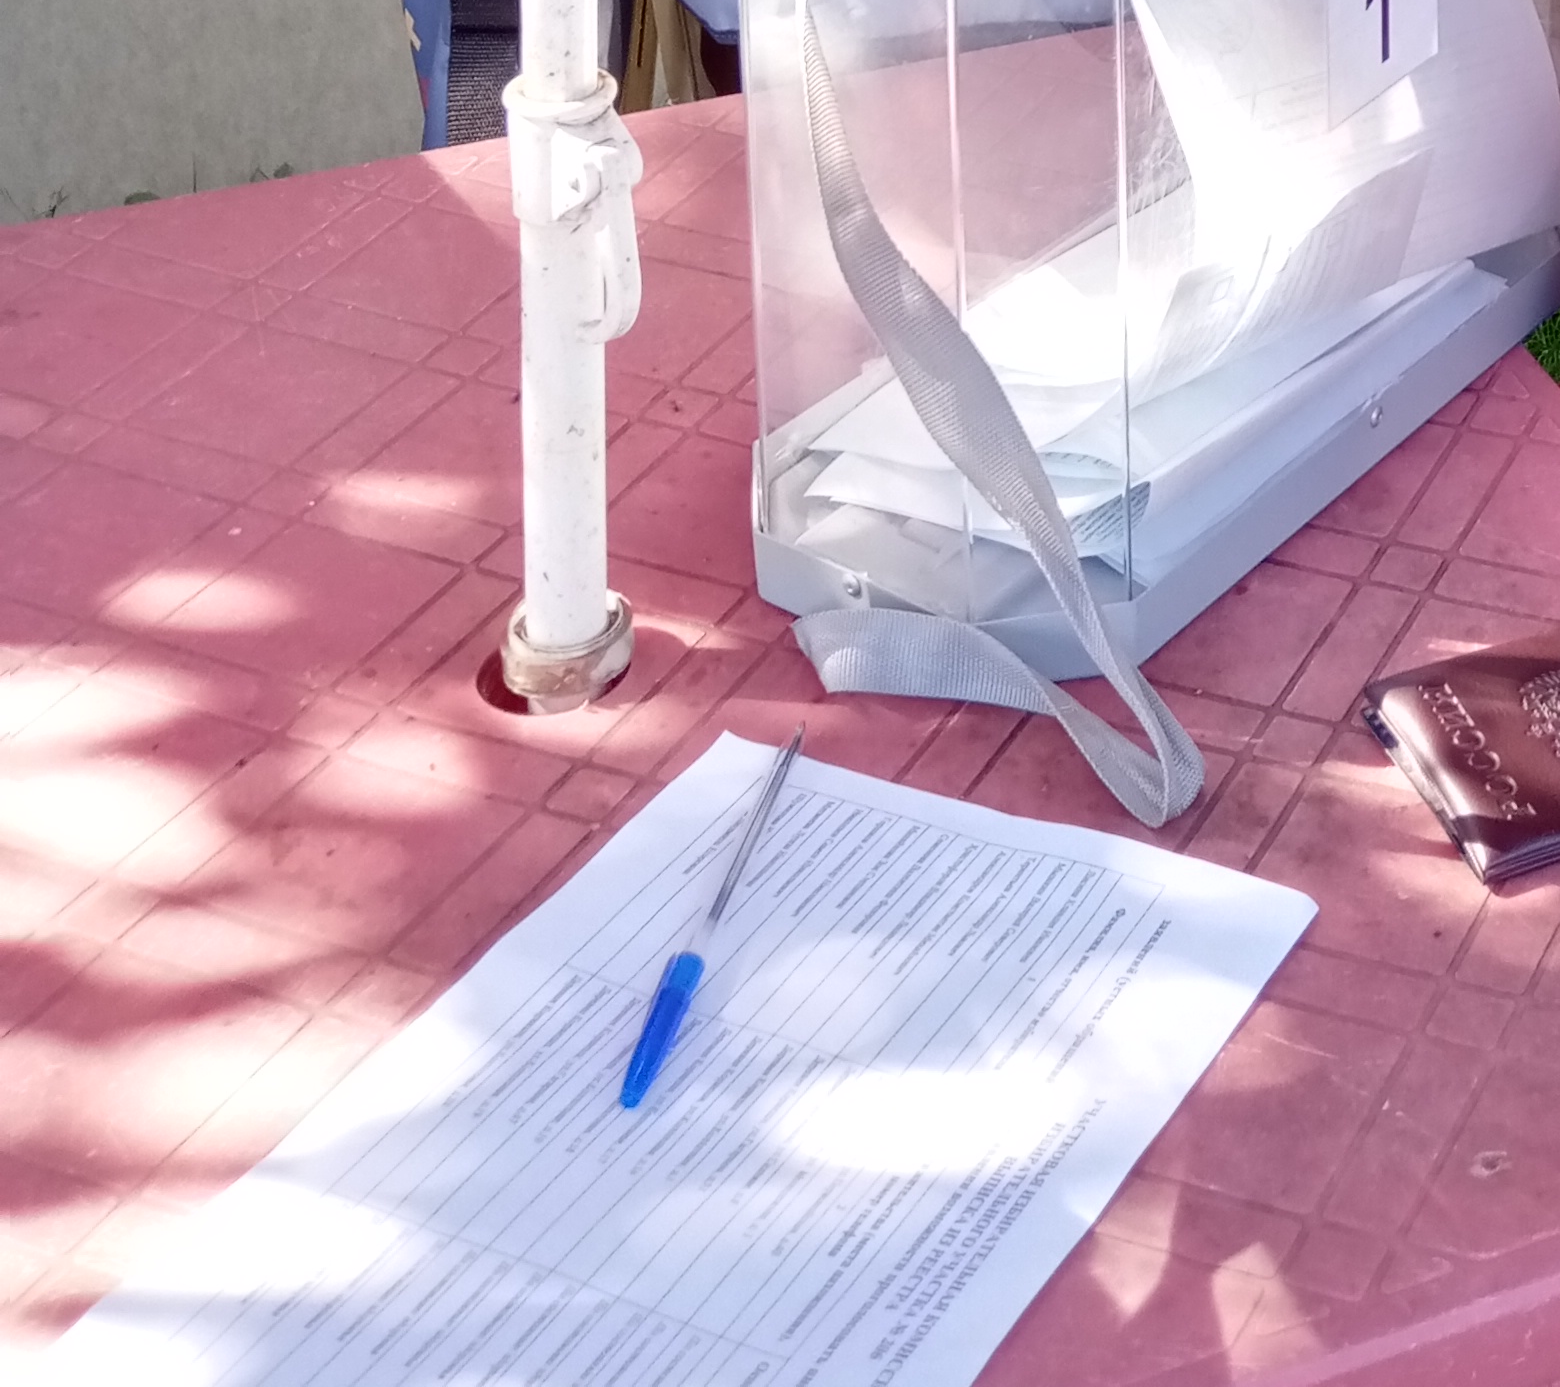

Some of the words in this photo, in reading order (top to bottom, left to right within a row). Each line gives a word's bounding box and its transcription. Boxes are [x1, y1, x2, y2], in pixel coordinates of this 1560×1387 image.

[1417, 682, 1538, 821] РОССИЯ
[1026, 1096, 1107, 1189] УЧАСТКОВАЯ
[882, 1245, 946, 1314] РЕЕСТРА
[900, 1247, 967, 1321] УЧАСТКА
[930, 1187, 1037, 1314] ИЗБИРАТЕЛЬНАЯ
